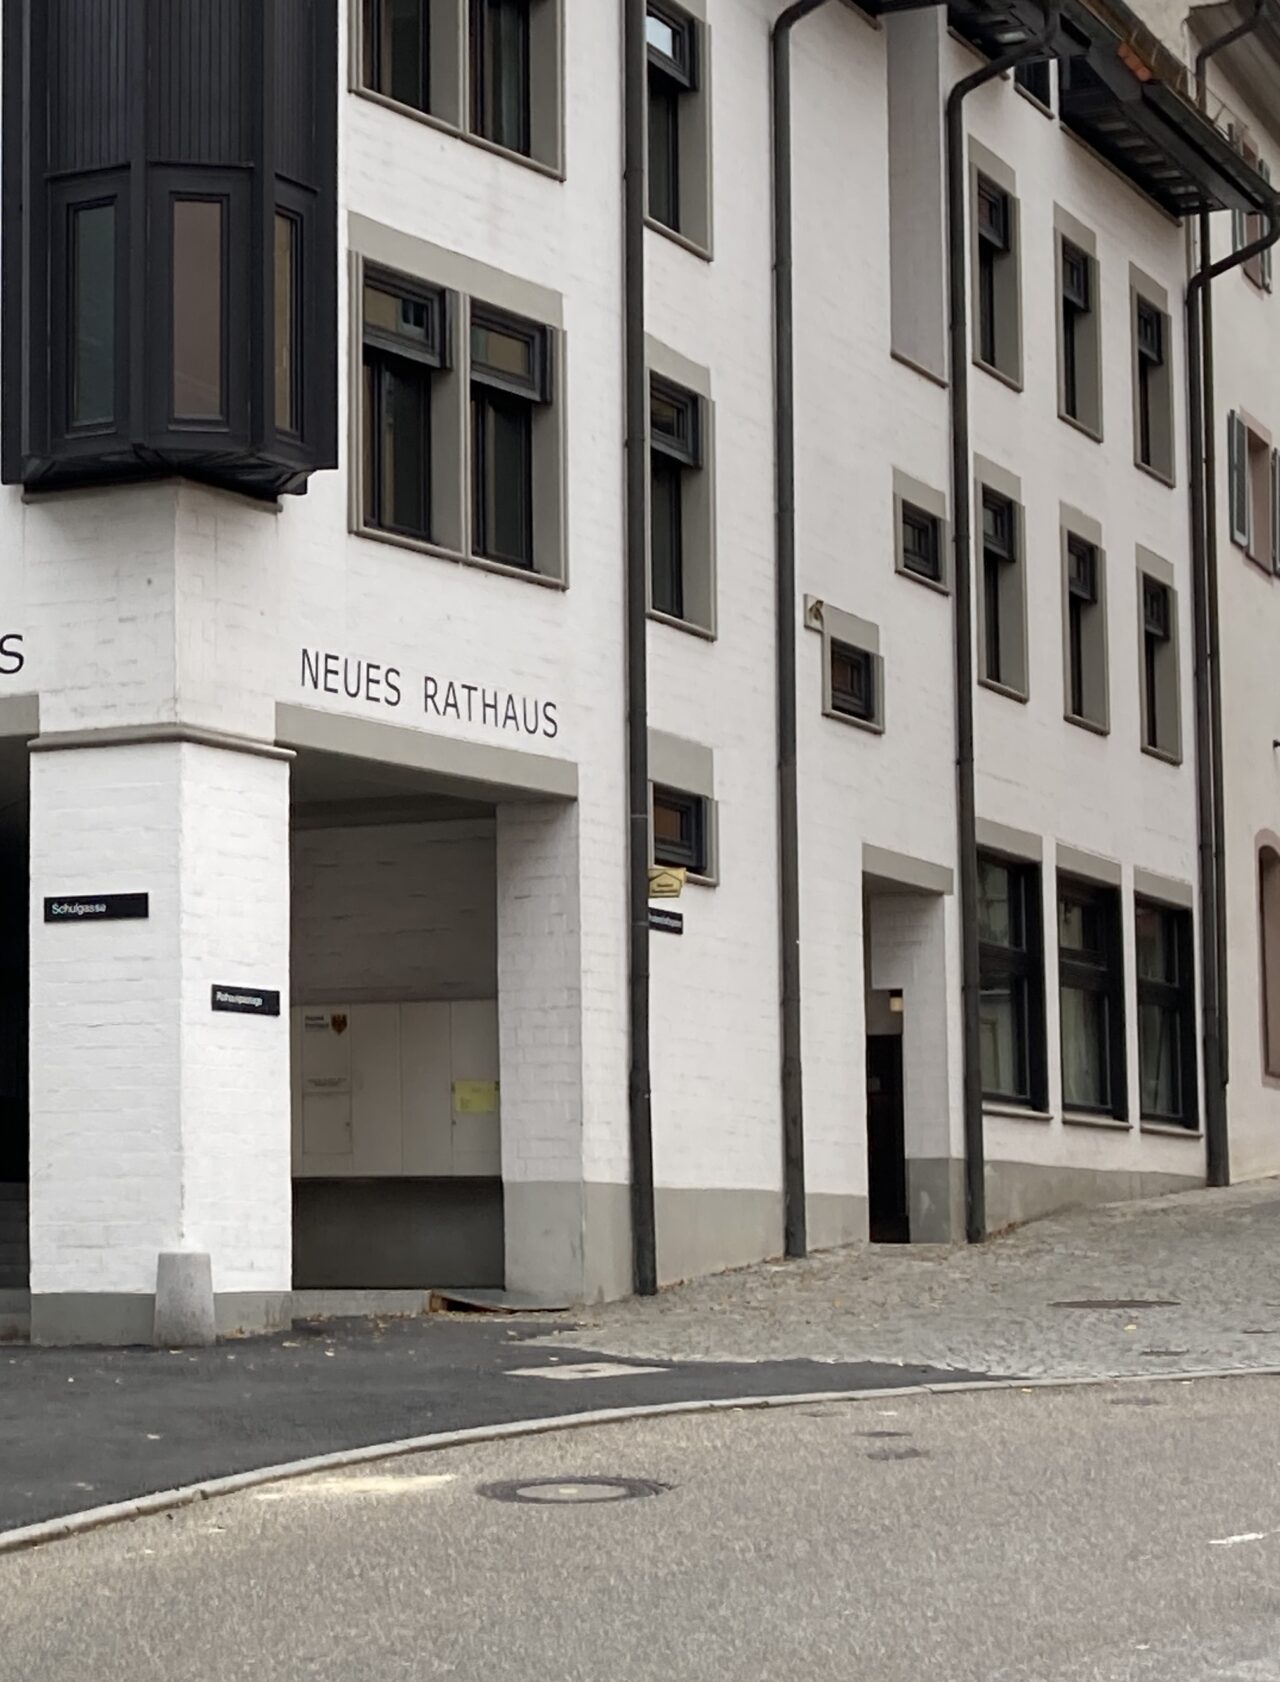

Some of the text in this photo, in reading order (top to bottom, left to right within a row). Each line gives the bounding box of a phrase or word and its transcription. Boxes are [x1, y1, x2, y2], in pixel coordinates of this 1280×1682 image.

[300, 648, 559, 739] NEUES RATHAUS
[51, 901, 107, 915] Schulgasse
